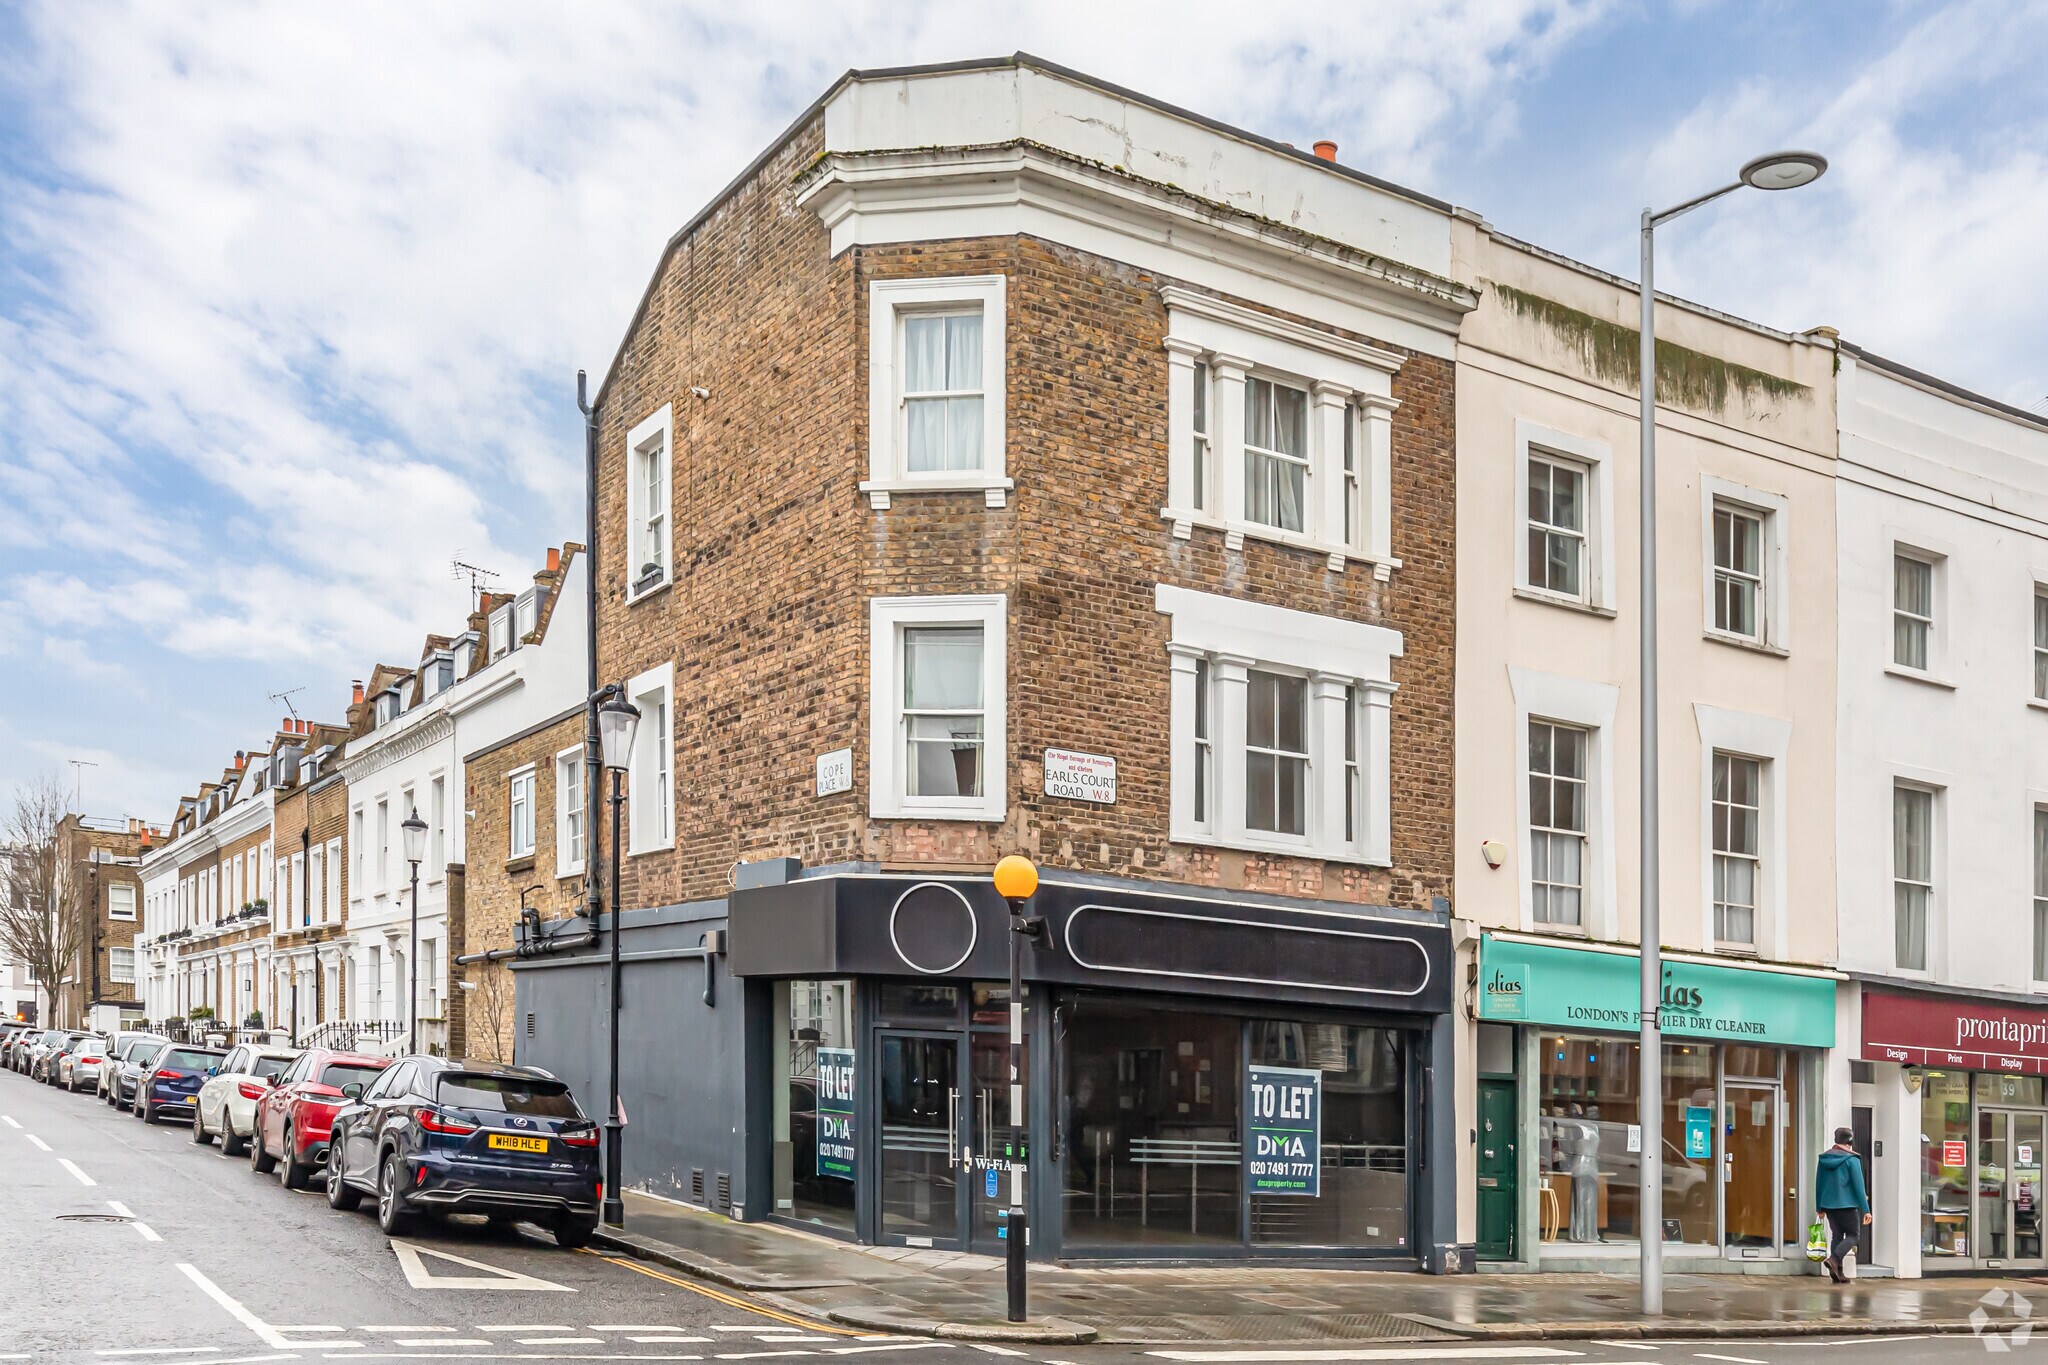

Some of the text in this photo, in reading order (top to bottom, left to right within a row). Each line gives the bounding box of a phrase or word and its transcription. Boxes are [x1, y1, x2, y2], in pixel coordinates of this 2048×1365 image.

[1057, 753, 1068, 761] Royal
[1070, 755, 1085, 764] Borough
[1092, 758, 1113, 767] Kensington
[823, 763, 843, 778] COPE
[1077, 765, 1093, 773] Chelsea
[819, 778, 836, 793] PLACE
[1046, 769, 1115, 788] EARLS COURT
[1488, 968, 1522, 992] elias
[1567, 1006, 1629, 1023] LONDON'S
[1690, 1016, 1712, 1029] DRY
[1715, 1018, 1766, 1034] CLEANER
[1956, 1017, 2048, 1051] prontapri
[1887, 1048, 1908, 1061] Design
[1947, 1053, 1963, 1063] Print
[2001, 1057, 2022, 1070] Display
[820, 1065, 855, 1101] TO LET
[2002, 1083, 2015, 1096] 39
[1251, 1084, 1313, 1119] TO LET
[824, 1116, 850, 1140] DMA
[496, 1136, 541, 1150] WH18 HLE
[820, 1143, 830, 1156] 020
[1257, 1135, 1306, 1157] DMA
[975, 1158, 1027, 1171] Wi-Fi Aa
[1251, 1161, 1313, 1176] 020 7491 7777
[1257, 1179, 1306, 1188] dmaproperty.com
